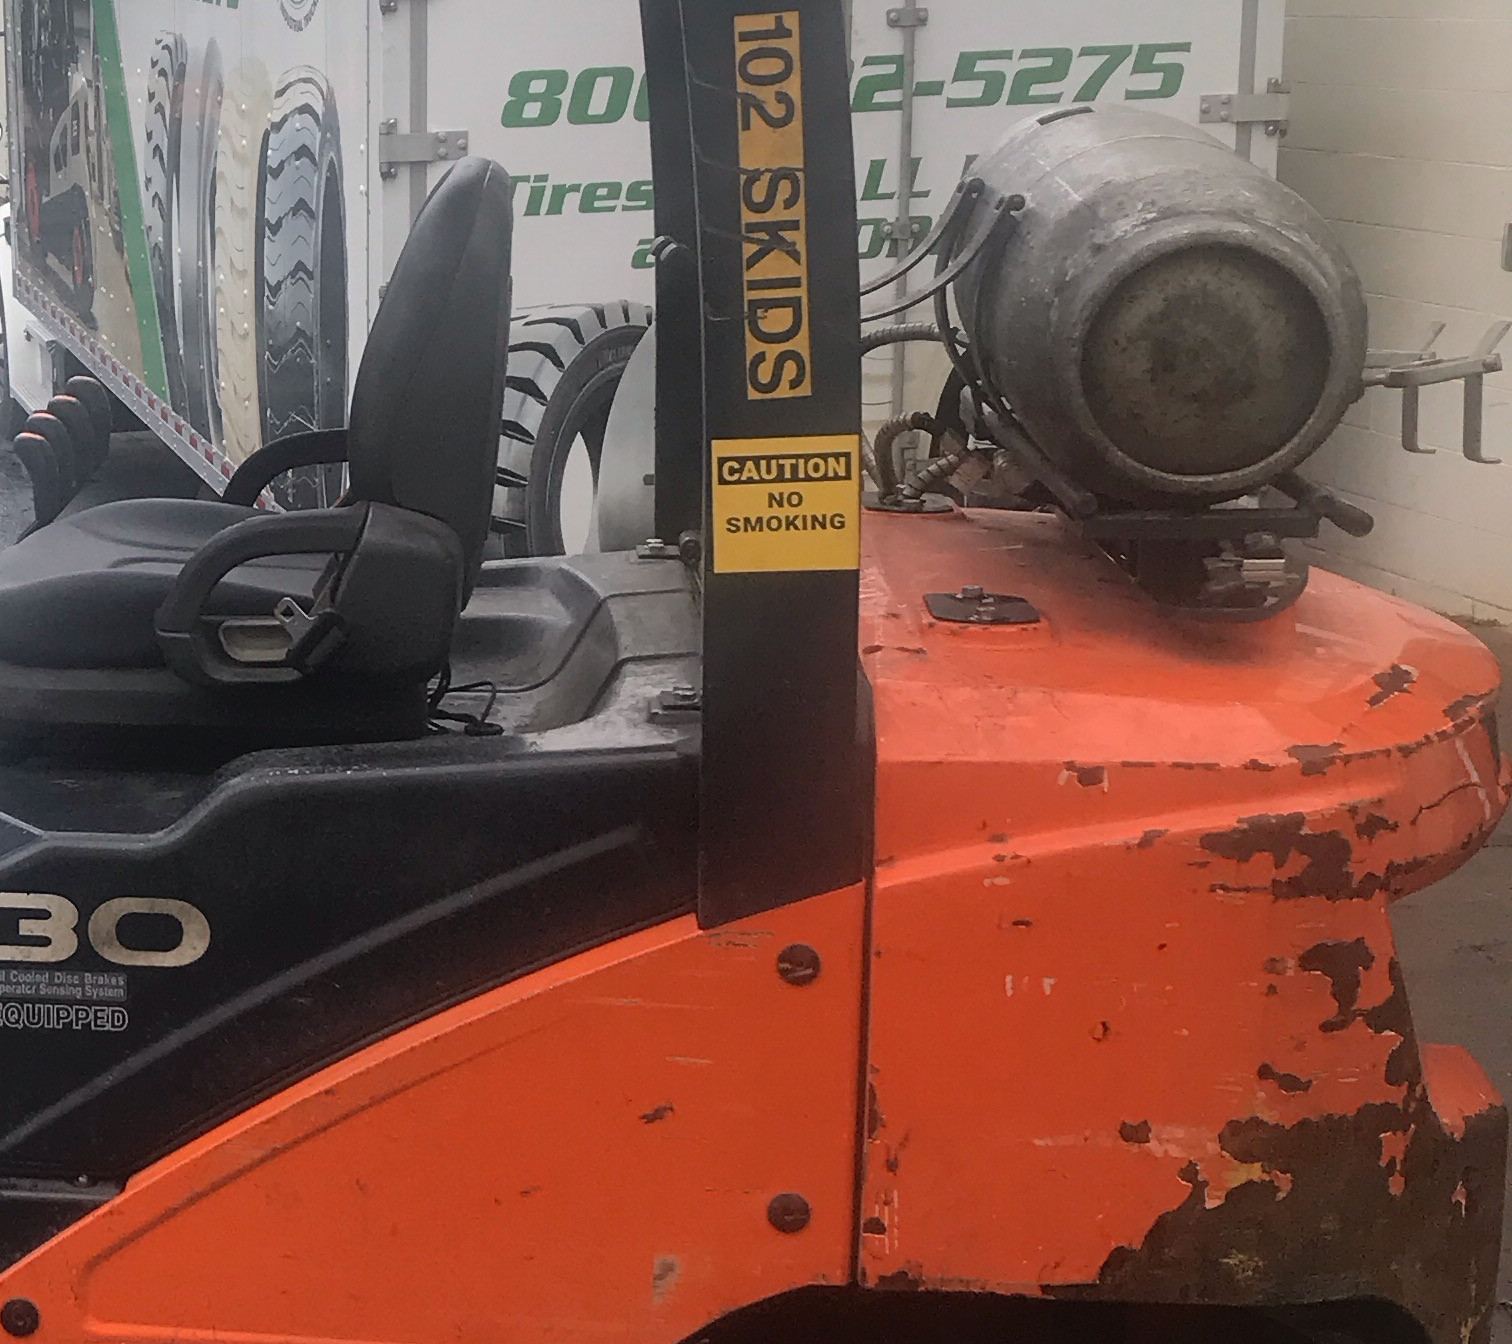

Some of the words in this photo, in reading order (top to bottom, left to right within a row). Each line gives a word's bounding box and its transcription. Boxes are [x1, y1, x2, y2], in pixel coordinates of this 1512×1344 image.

[736, 15, 797, 131] 102
[500, 66, 650, 128] 80
[851, 42, 1192, 113] 2-5275
[741, 167, 807, 396] SKIDS
[721, 457, 847, 481] CAUTION
[767, 491, 804, 509] NO
[725, 513, 846, 534] SMOKING
[10, 971, 49, 984] Cooled
[54, 972, 79, 985] Disc
[84, 973, 125, 987] Brakes
[39, 984, 82, 999] Sensing
[84, 985, 125, 1000] System
